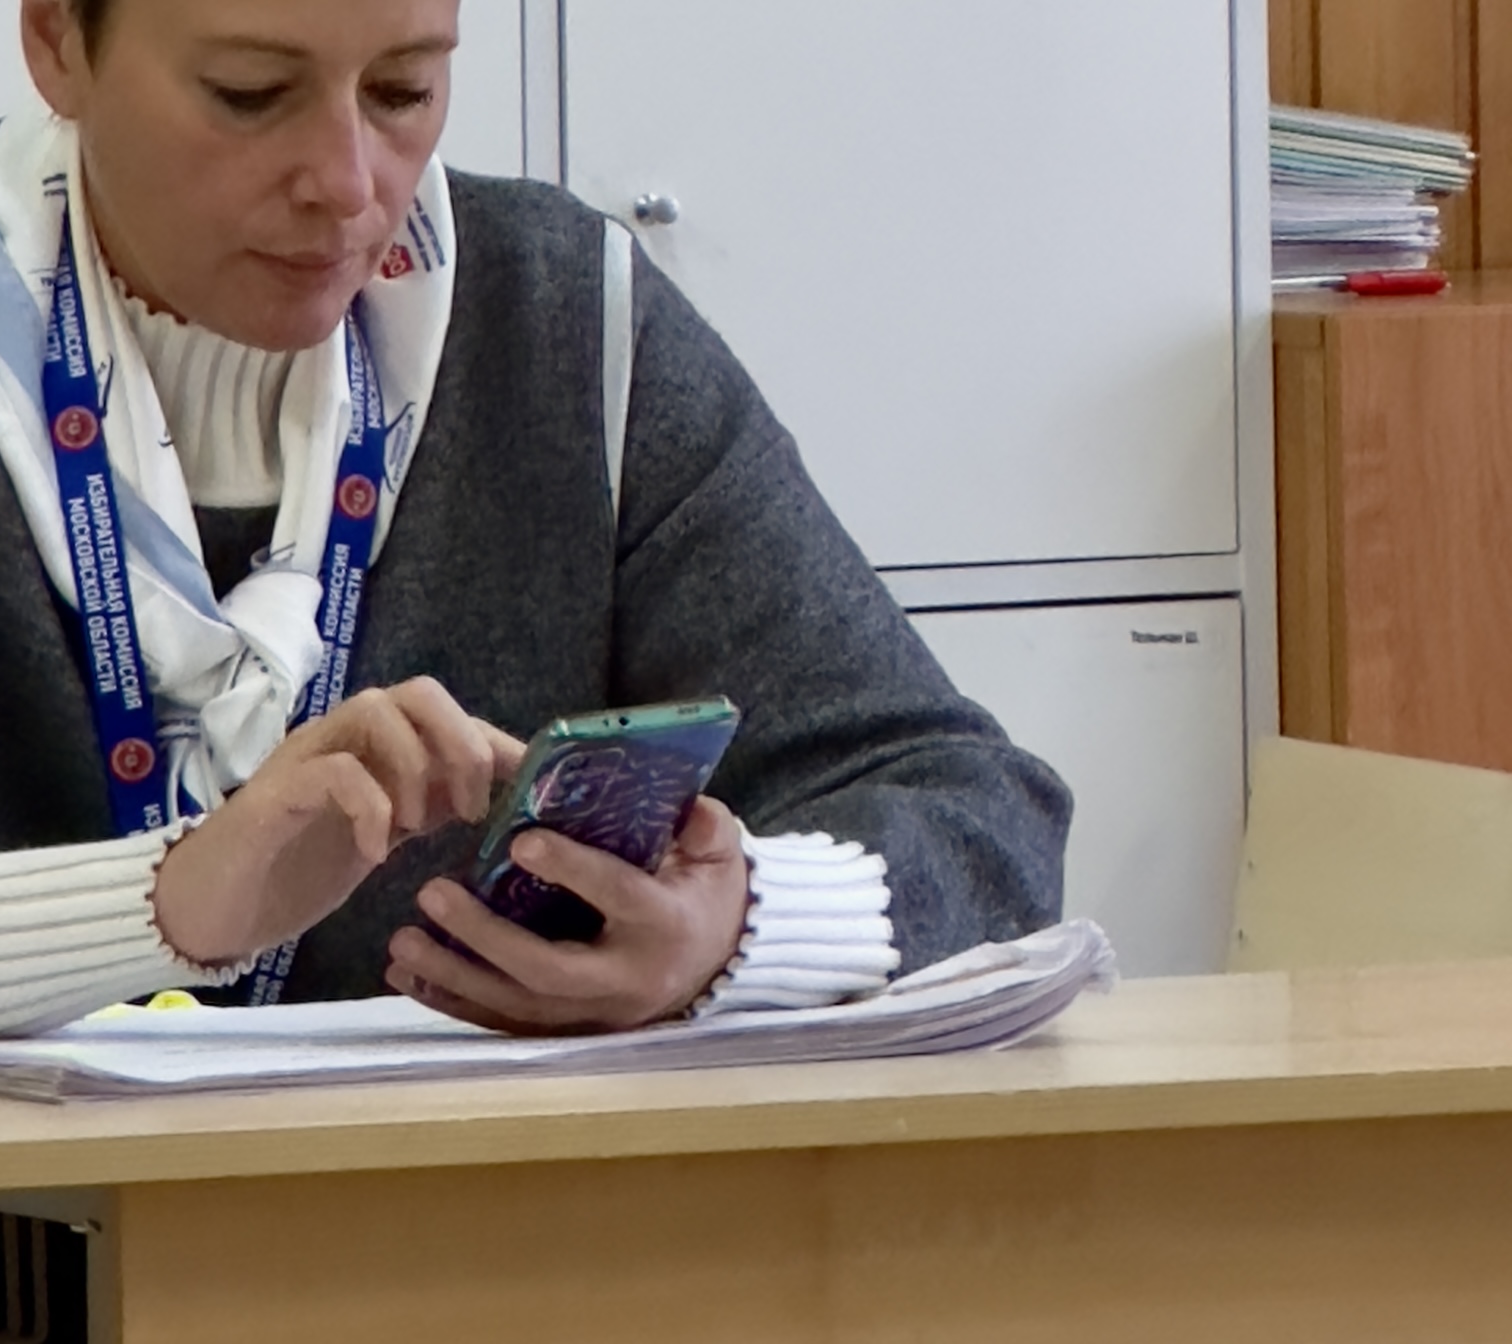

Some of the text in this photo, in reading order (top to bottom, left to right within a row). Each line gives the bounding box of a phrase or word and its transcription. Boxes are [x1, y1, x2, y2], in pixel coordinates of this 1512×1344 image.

[58, 286, 87, 378] КОМИССИЯ
[68, 497, 117, 694] МОСКОВСКОЙ ОБЛАСТИ
[87, 473, 142, 710] ИЗБИРАТЕЛЬНАЯ КОМИССИЯ
[324, 543, 351, 637] КОМИССИЯ
[339, 567, 364, 644] ОБЛАСТИ
